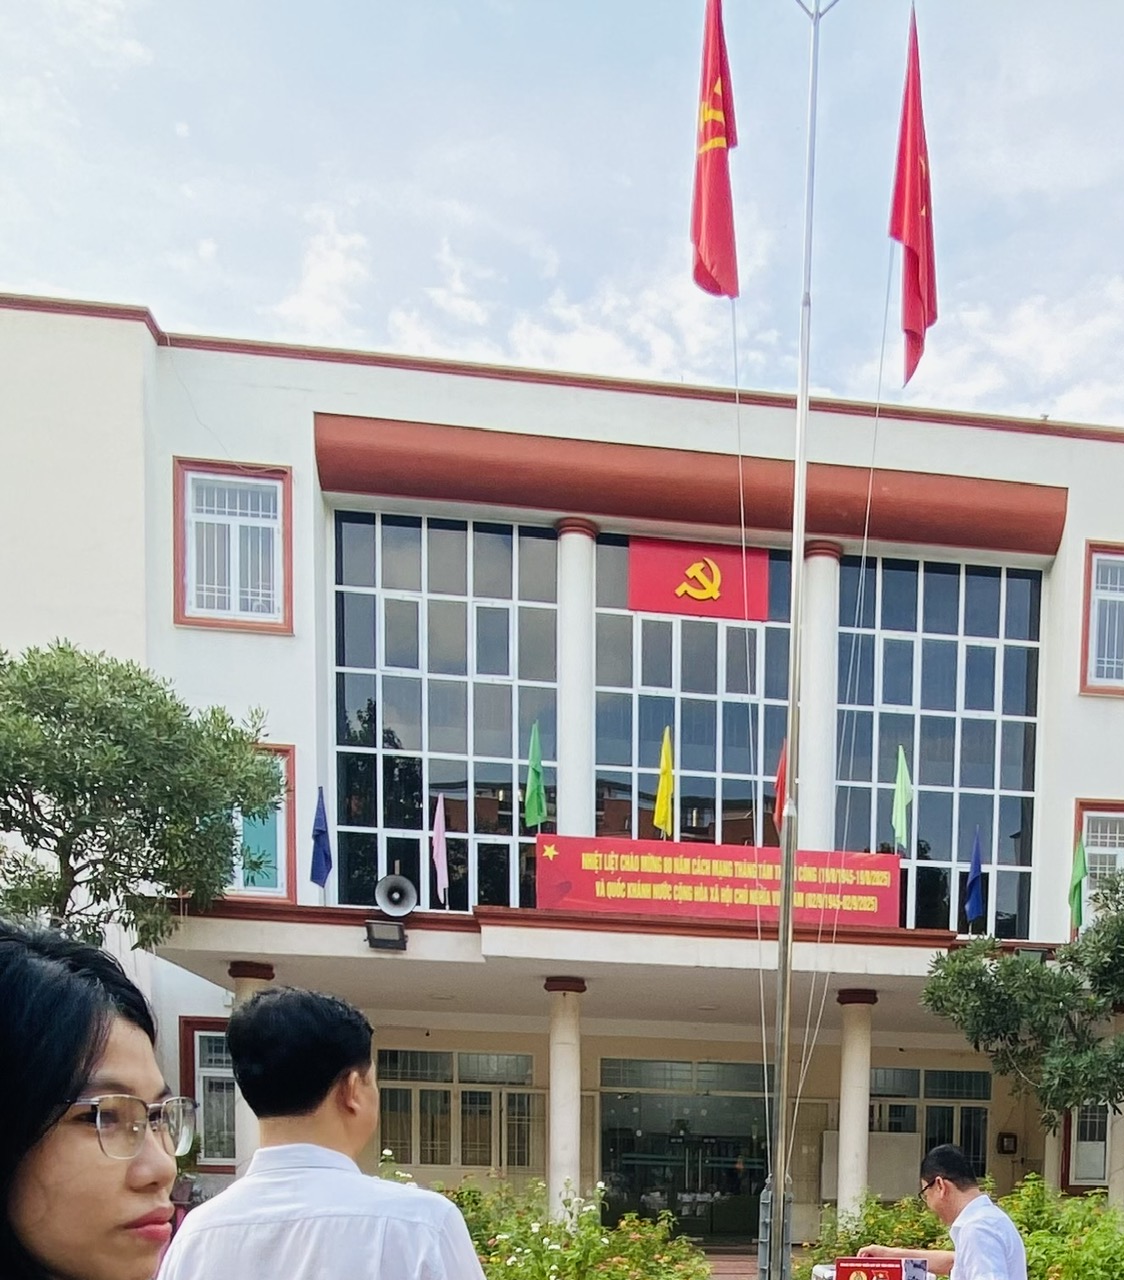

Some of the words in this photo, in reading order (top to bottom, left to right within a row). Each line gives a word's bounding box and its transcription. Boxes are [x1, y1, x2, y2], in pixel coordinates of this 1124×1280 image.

[603, 850, 620, 875] LIỆT
[691, 855, 711, 876] CÁCH
[595, 878, 606, 898] VÀ
